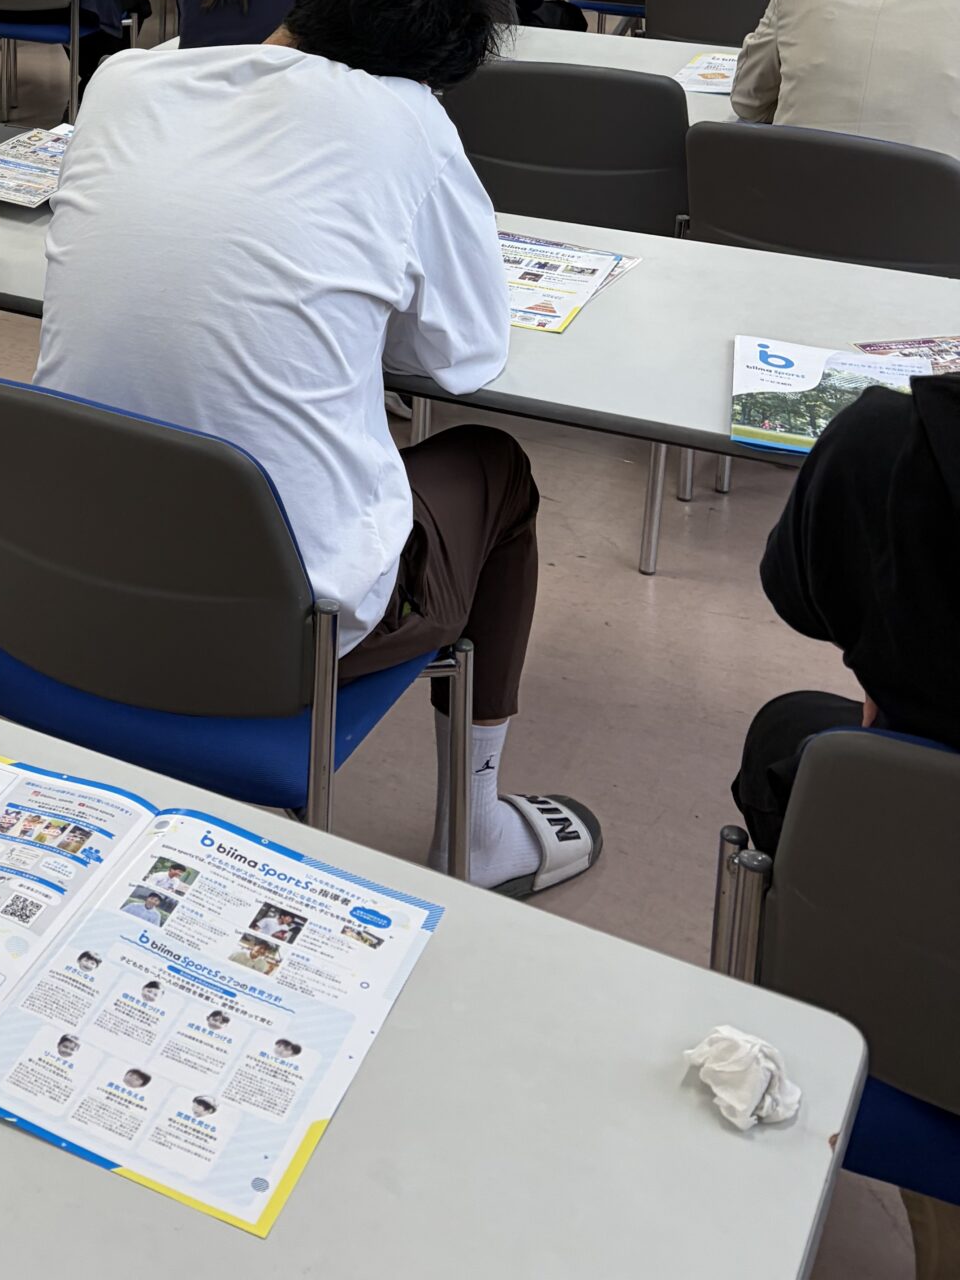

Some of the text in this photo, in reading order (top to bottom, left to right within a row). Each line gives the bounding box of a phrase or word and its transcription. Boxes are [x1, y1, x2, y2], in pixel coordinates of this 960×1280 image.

[213, 842, 260, 869] biima
[147, 939, 183, 961] biima
[62, 964, 97, 983] 好きになる
[119, 991, 168, 1017] 個性を見つける
[185, 1020, 235, 1045] 成長を見つける
[41, 1049, 76, 1070] リードする
[257, 1049, 301, 1072] 聞いてあげる
[173, 1109, 219, 1134] 笑顔を見せる
